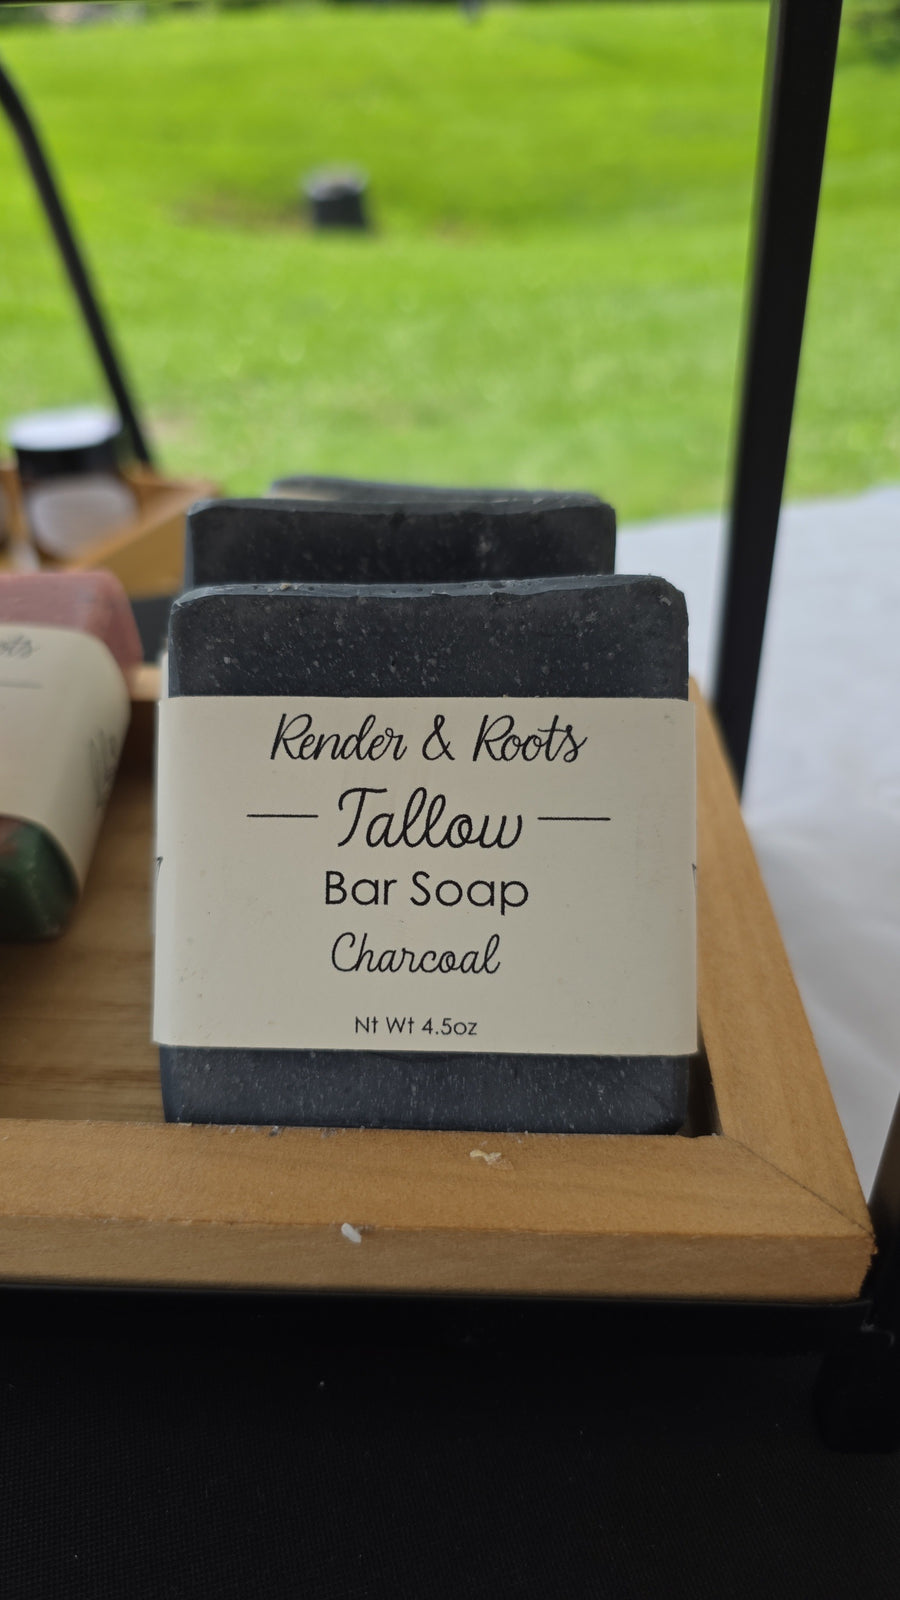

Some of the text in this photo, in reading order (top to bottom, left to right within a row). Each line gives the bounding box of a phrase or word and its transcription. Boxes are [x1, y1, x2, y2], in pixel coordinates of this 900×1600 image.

[270, 714, 588, 764] Render & Roots
[338, 787, 523, 850] Tallow
[325, 870, 529, 916] Bar Soap
[331, 931, 501, 975] Charcoal
[355, 1016, 478, 1036] Nt Wt 4.5oz
